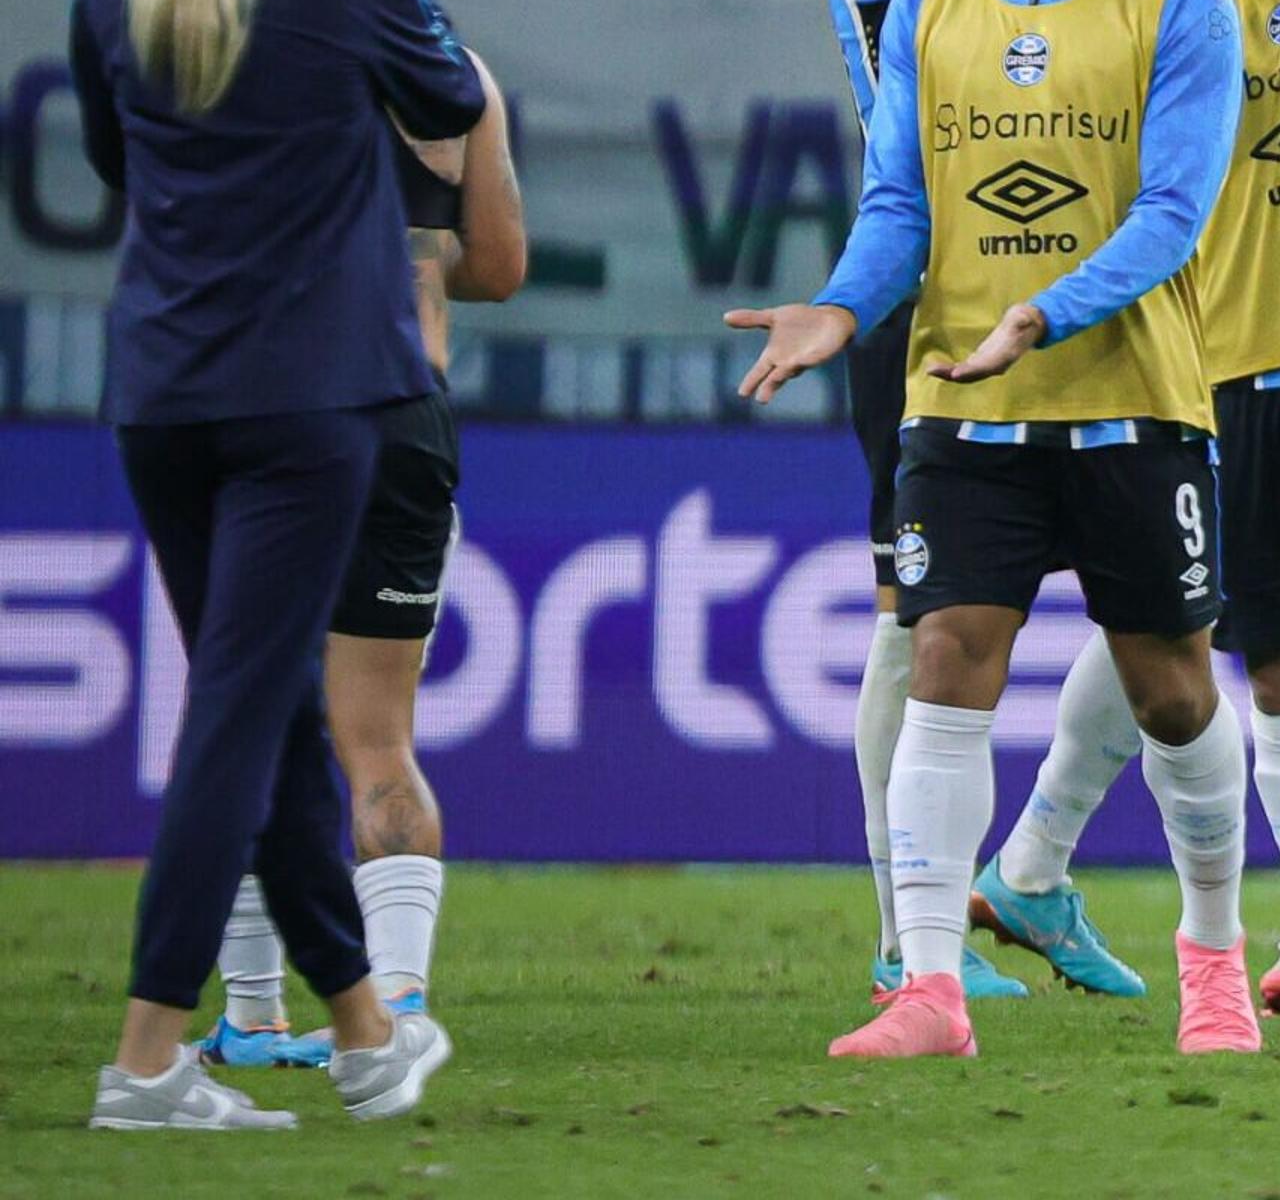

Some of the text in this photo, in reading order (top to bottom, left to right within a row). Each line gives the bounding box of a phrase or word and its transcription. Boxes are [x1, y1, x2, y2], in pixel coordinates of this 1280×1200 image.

[969, 104, 1130, 145] banrisul
[978, 229, 1078, 257] umbro
[1175, 482, 1205, 558] 9
